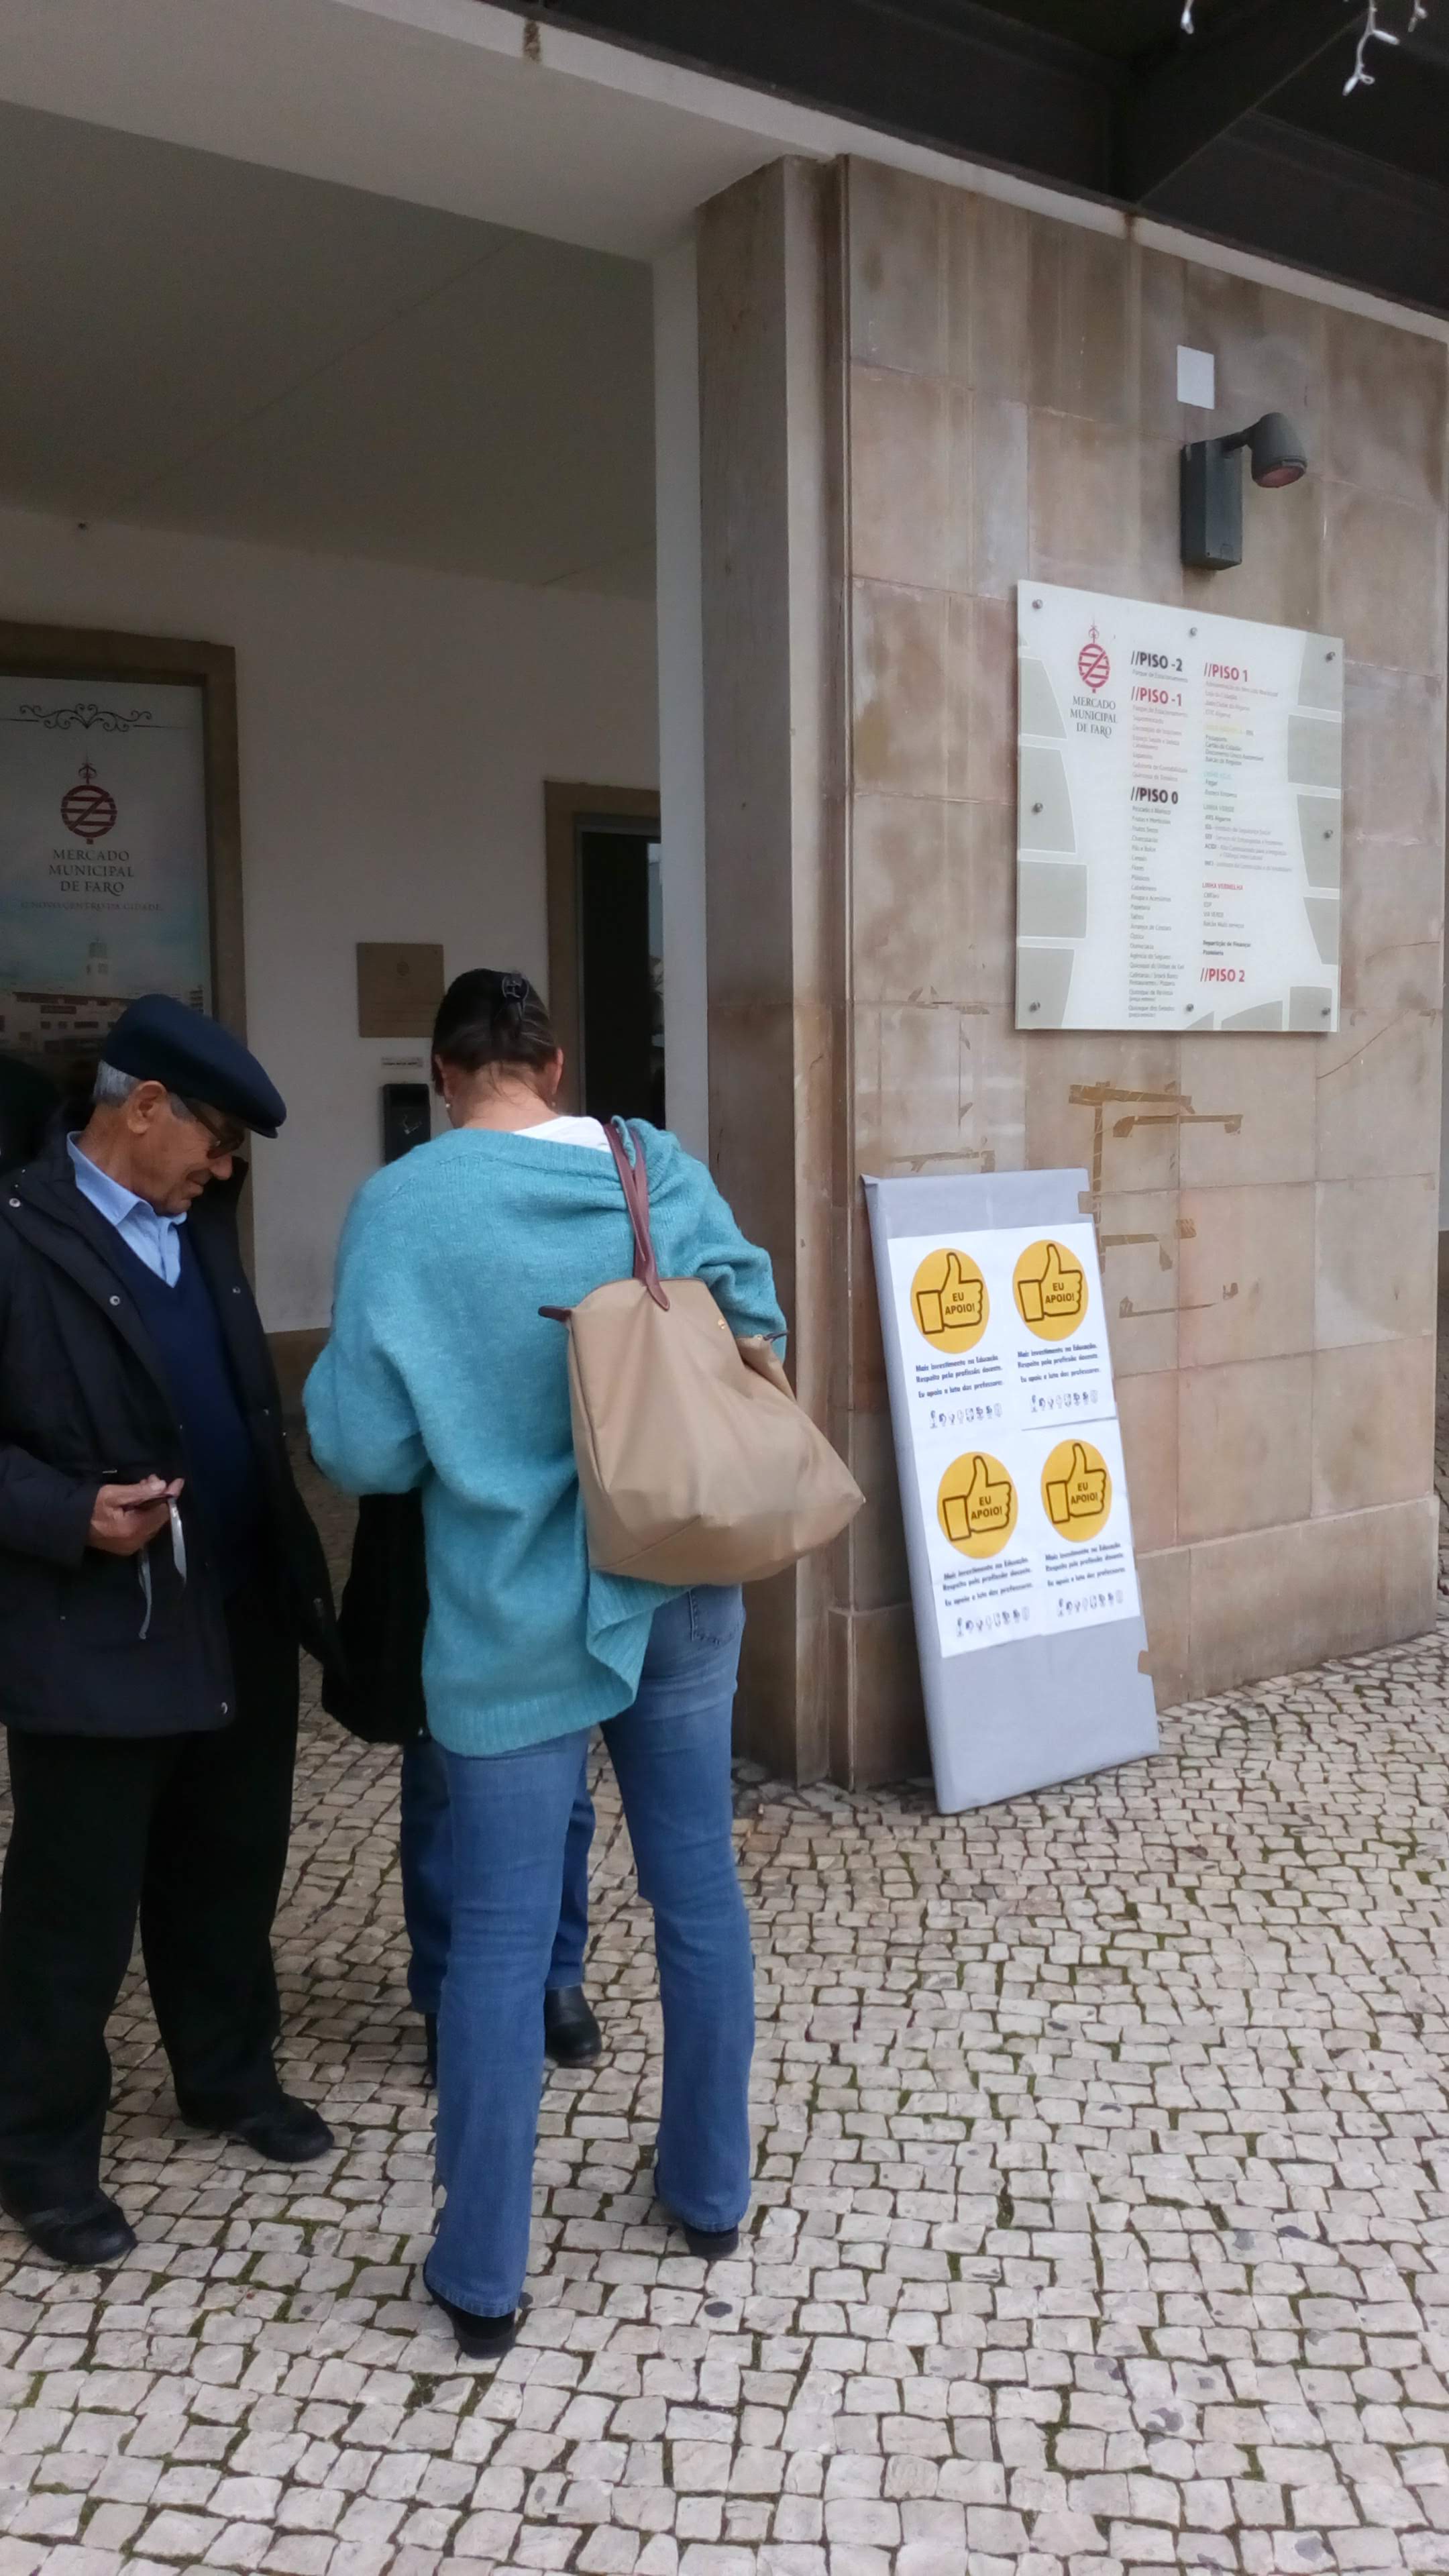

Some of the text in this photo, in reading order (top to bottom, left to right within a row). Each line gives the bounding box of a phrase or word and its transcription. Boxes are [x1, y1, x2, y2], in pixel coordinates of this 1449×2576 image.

[1131, 650, 1183, 672] //PISO -2
[1204, 662, 1248, 682] //PISO 1
[1073, 696, 1116, 709] MERCADO
[1131, 686, 1181, 706] //PISO -1
[1070, 708, 1117, 723] MUNICIPAL
[1077, 722, 1112, 739] DE FARO
[1130, 786, 1178, 804] //PISO 0
[53, 849, 129, 861] MERCADO
[49, 865, 133, 877] MUNICIPAL
[60, 881, 124, 896] DE FARO
[1200, 968, 1245, 982] //PISO 2
[1053, 1283, 1064, 1291] EU
[953, 1292, 964, 1302] EU
[1045, 1293, 1075, 1304] APOIO!
[945, 1303, 975, 1316] APOIO!
[1078, 1483, 1089, 1491] EU
[979, 1496, 991, 1507] EU
[1071, 1492, 1098, 1505] APOIO!
[971, 1506, 1002, 1520] APOIO!
